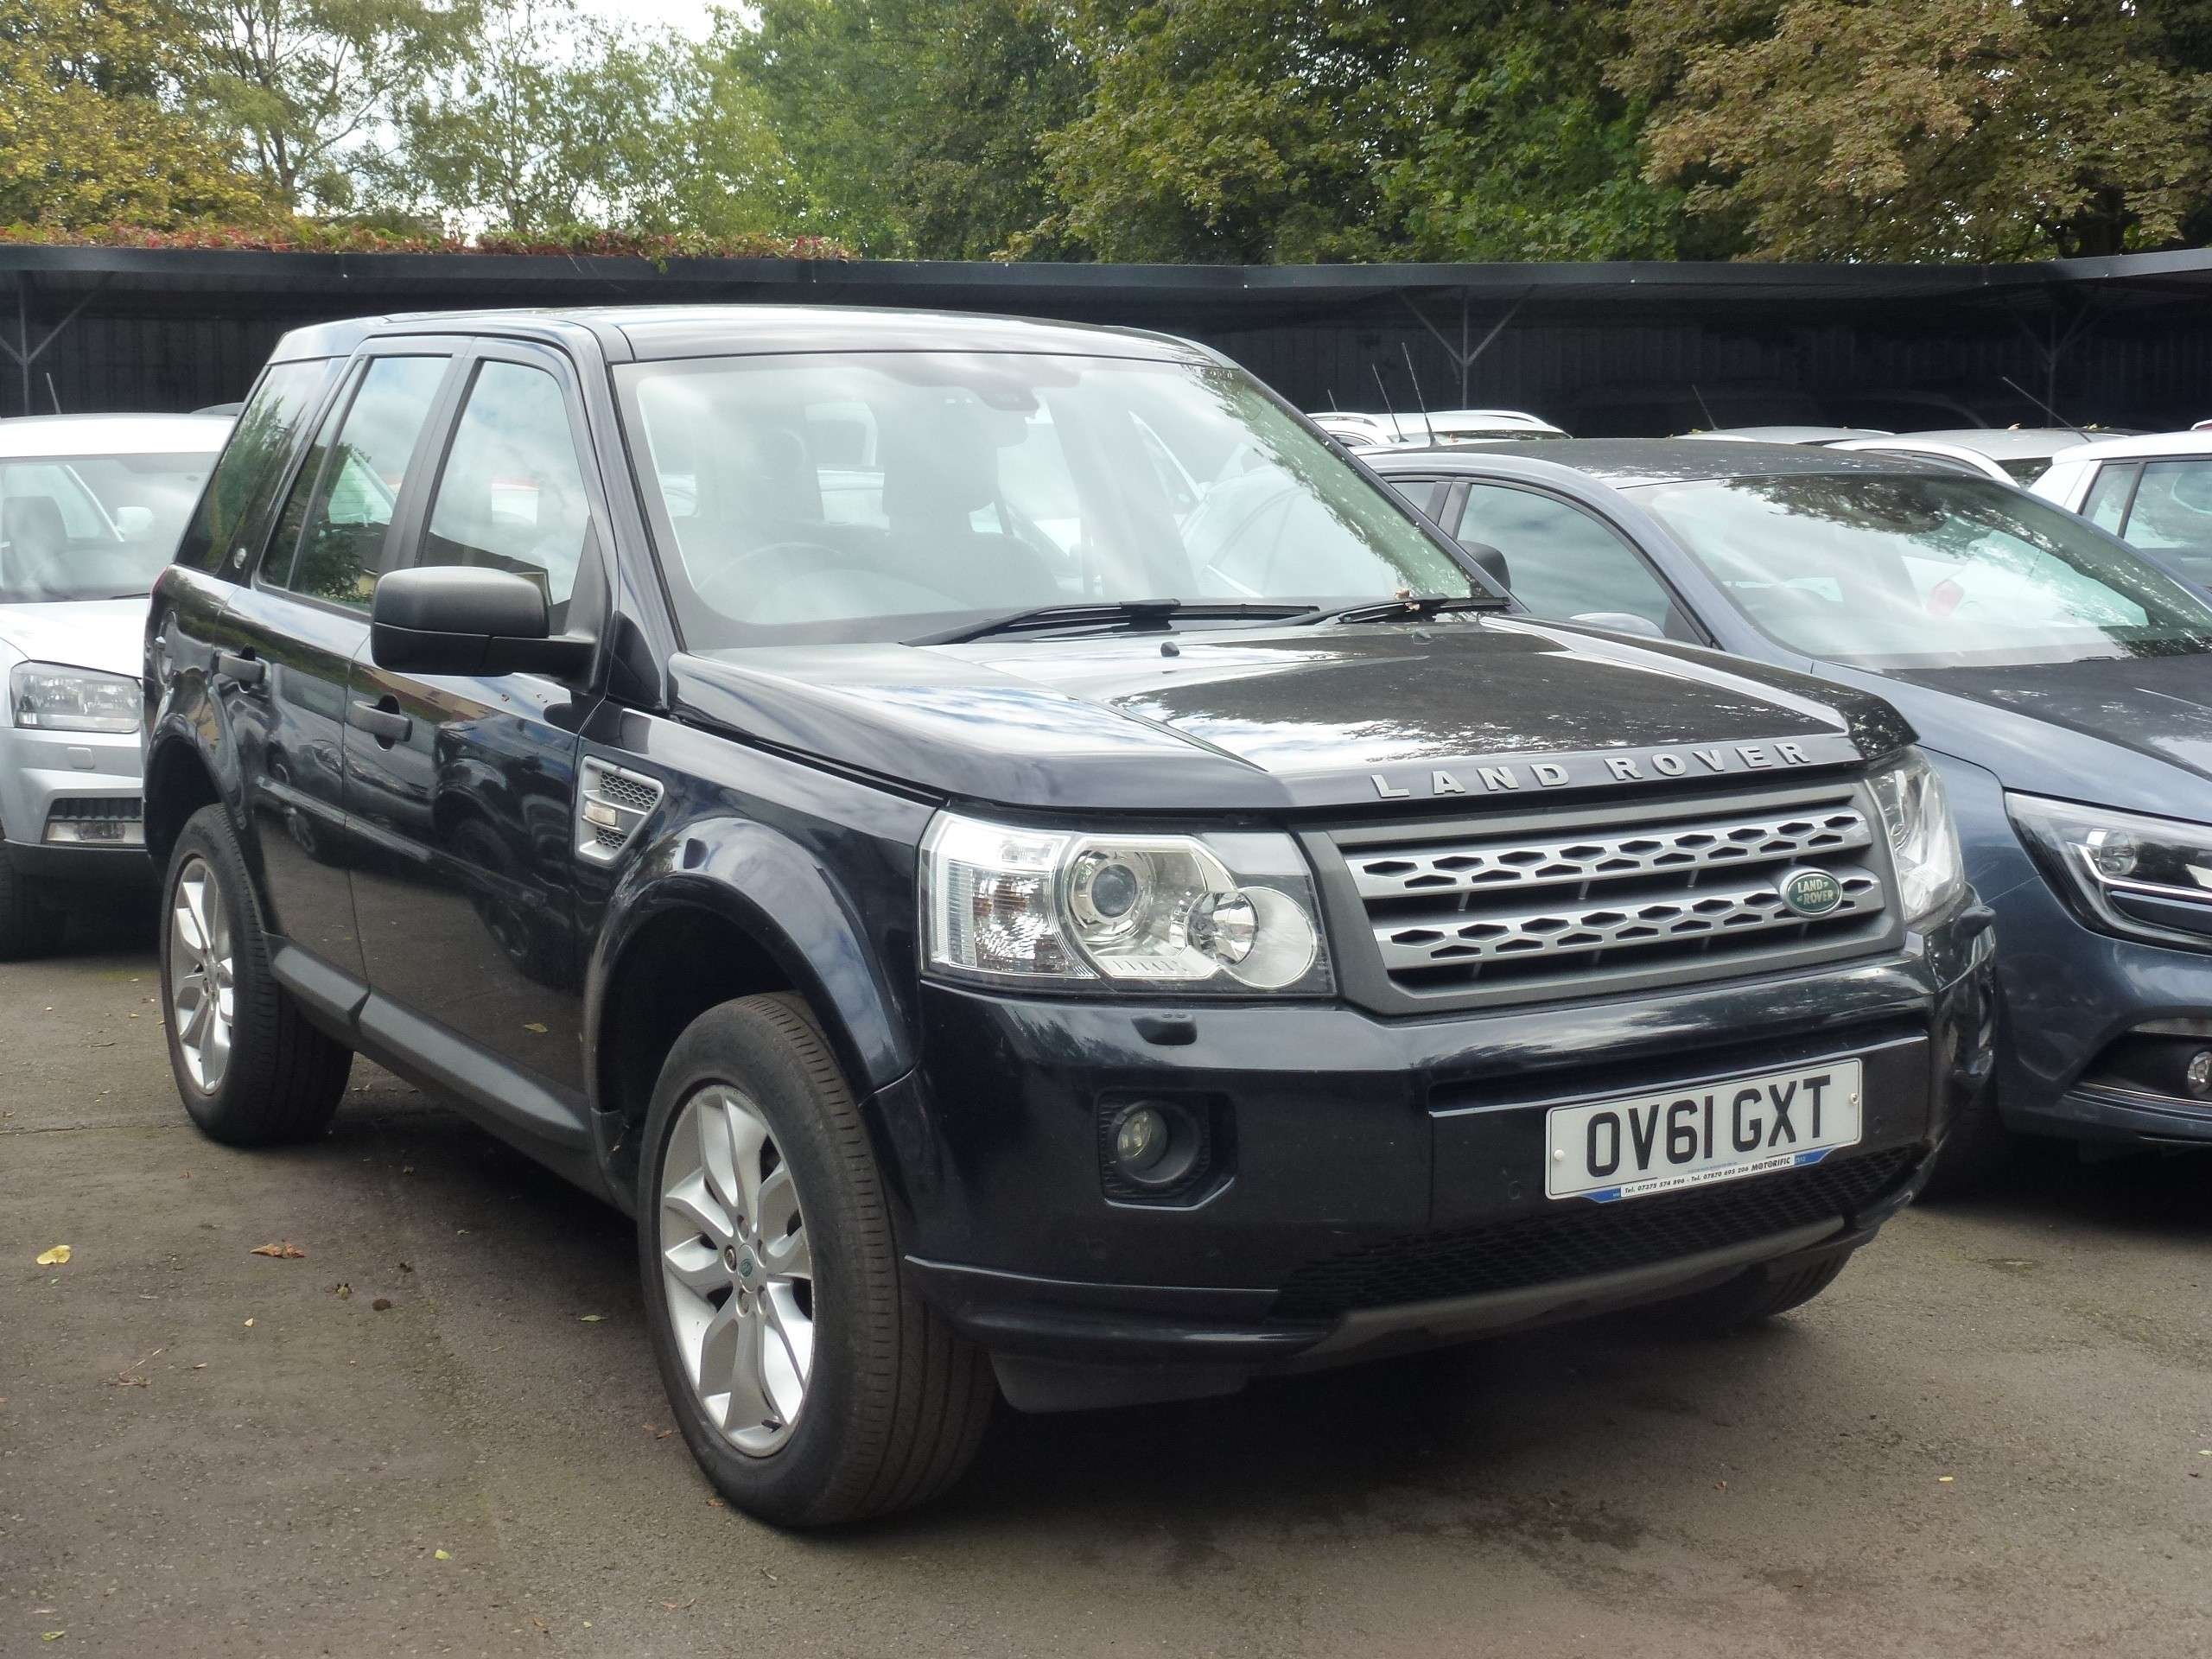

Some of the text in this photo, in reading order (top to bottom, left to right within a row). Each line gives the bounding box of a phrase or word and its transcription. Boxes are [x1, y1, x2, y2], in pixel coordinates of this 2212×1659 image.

[1370, 741, 1811, 798] LAND ROVER
[1797, 879, 1823, 893] LAND
[1803, 889, 1834, 905] ROVER
[1586, 1074, 1831, 1178] OV61 GXT
[1751, 1157, 1791, 1172] MOTORIFIC
